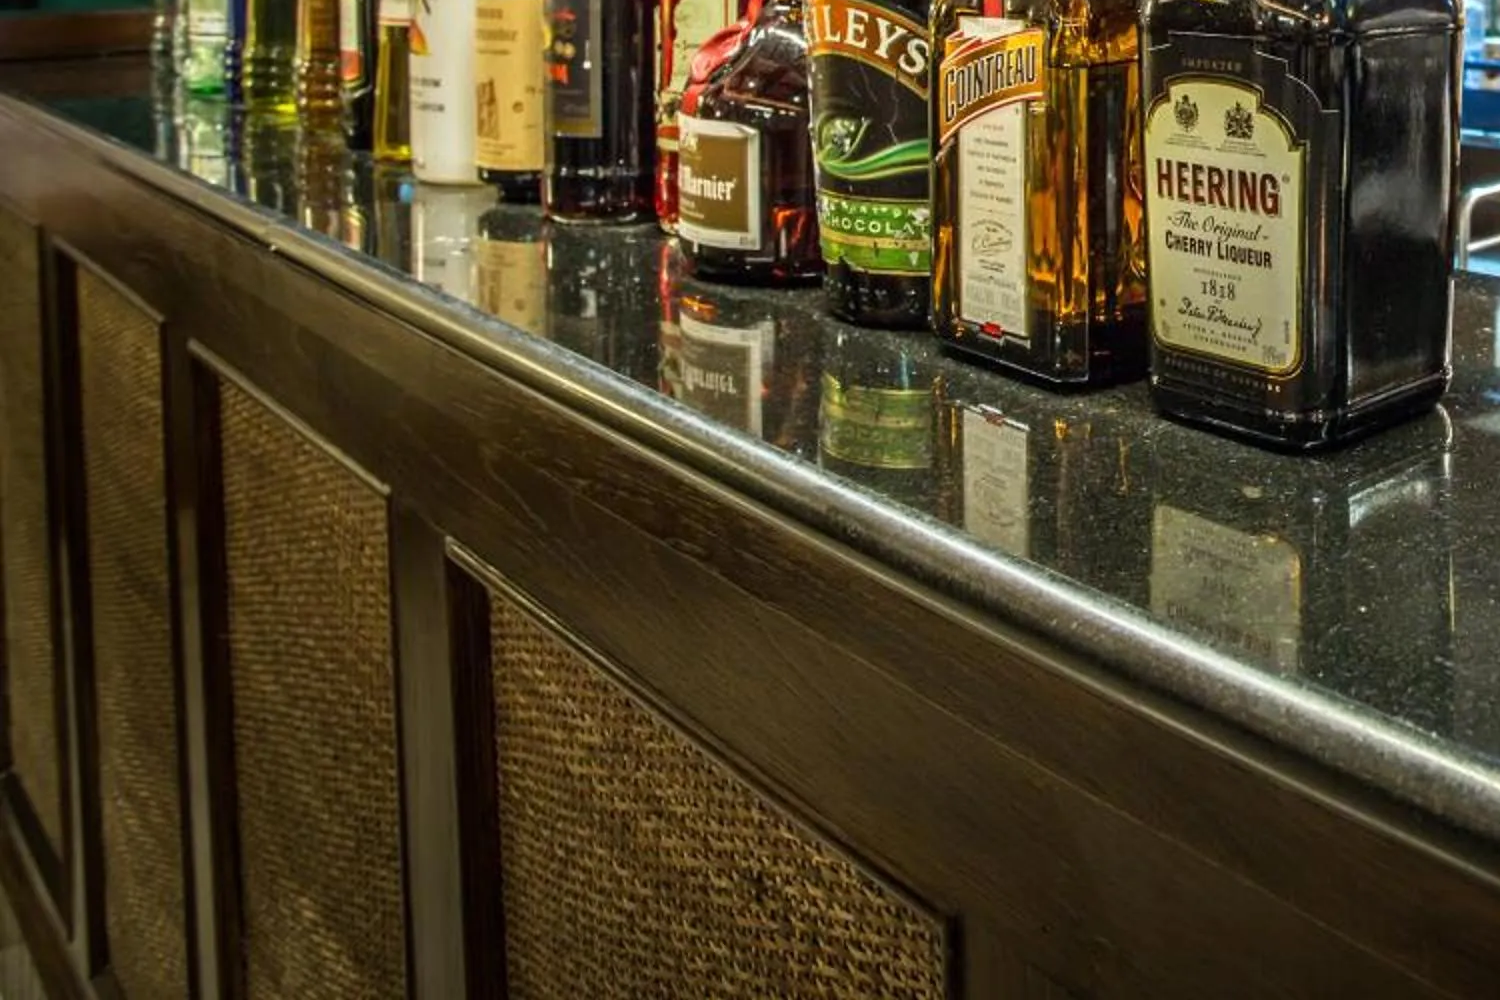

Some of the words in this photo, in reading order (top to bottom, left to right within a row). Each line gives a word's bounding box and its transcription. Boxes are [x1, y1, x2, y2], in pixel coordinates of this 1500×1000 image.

[804, 4, 929, 74] ILEYS
[944, 44, 1037, 124] COINTREAU
[1156, 157, 1281, 219] HEERING
[1165, 230, 1213, 258] CHERRY
[1217, 240, 1273, 269] LIQUEUR
[1171, 209, 1199, 231] The
[1202, 215, 1262, 241] Original
[1200, 279, 1236, 302] 1818
